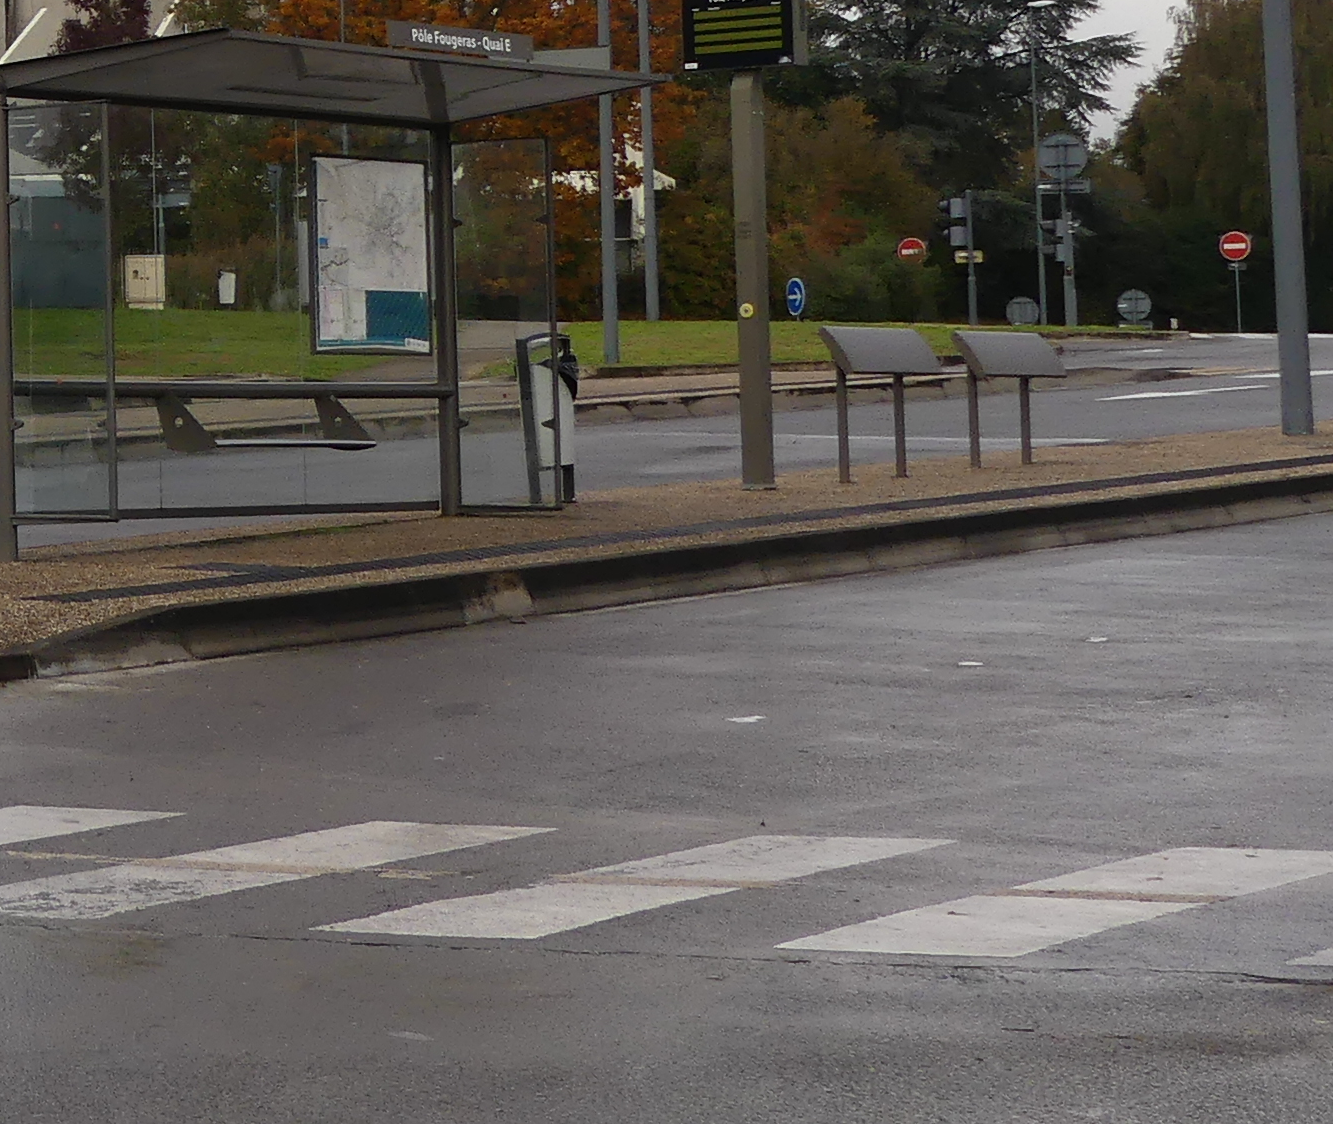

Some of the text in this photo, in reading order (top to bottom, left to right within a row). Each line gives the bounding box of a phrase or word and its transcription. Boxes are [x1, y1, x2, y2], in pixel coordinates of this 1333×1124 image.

[412, 29, 432, 44] Pôle
[434, 31, 476, 49] Fougeras
[482, 37, 504, 51] Quai
[505, 39, 511, 52] E
